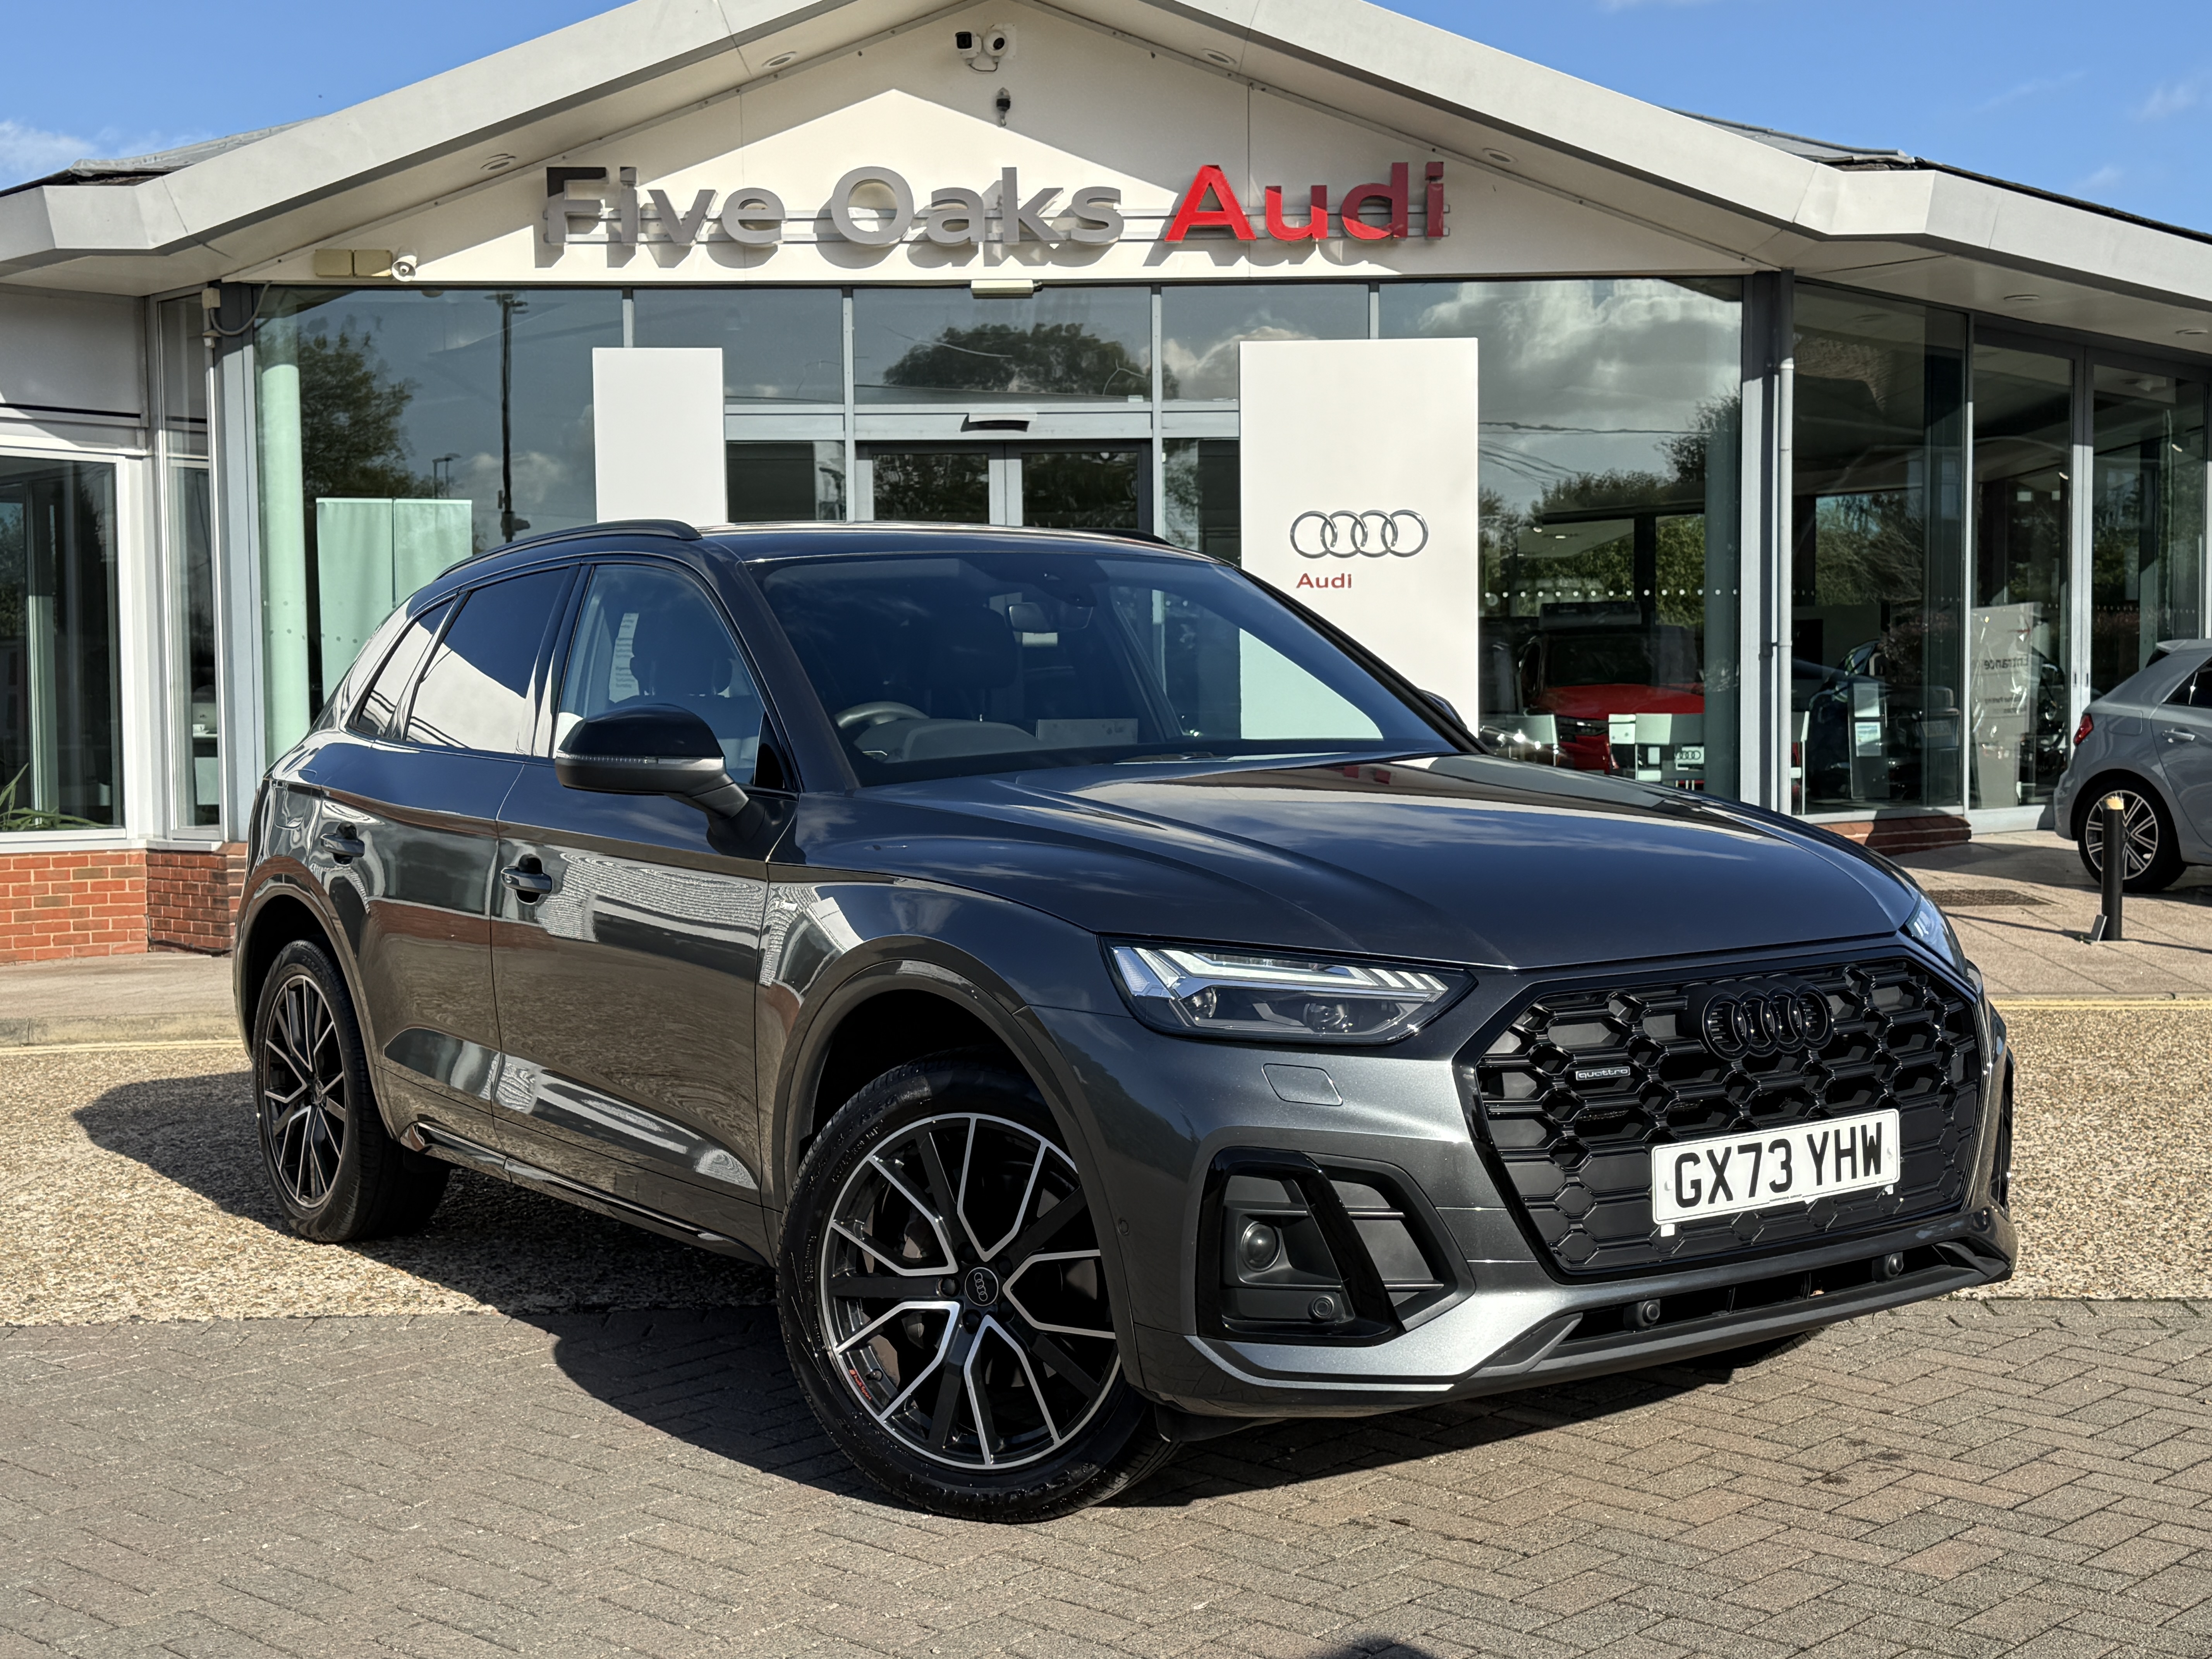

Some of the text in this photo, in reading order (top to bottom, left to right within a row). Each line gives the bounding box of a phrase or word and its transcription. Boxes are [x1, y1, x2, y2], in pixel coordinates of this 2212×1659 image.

[546, 161, 1444, 246] Five Oaks Audi
[1296, 573, 1352, 589] Audi
[1578, 1069, 1628, 1079] quattro
[1674, 1121, 1882, 1209] GX73 YHW
